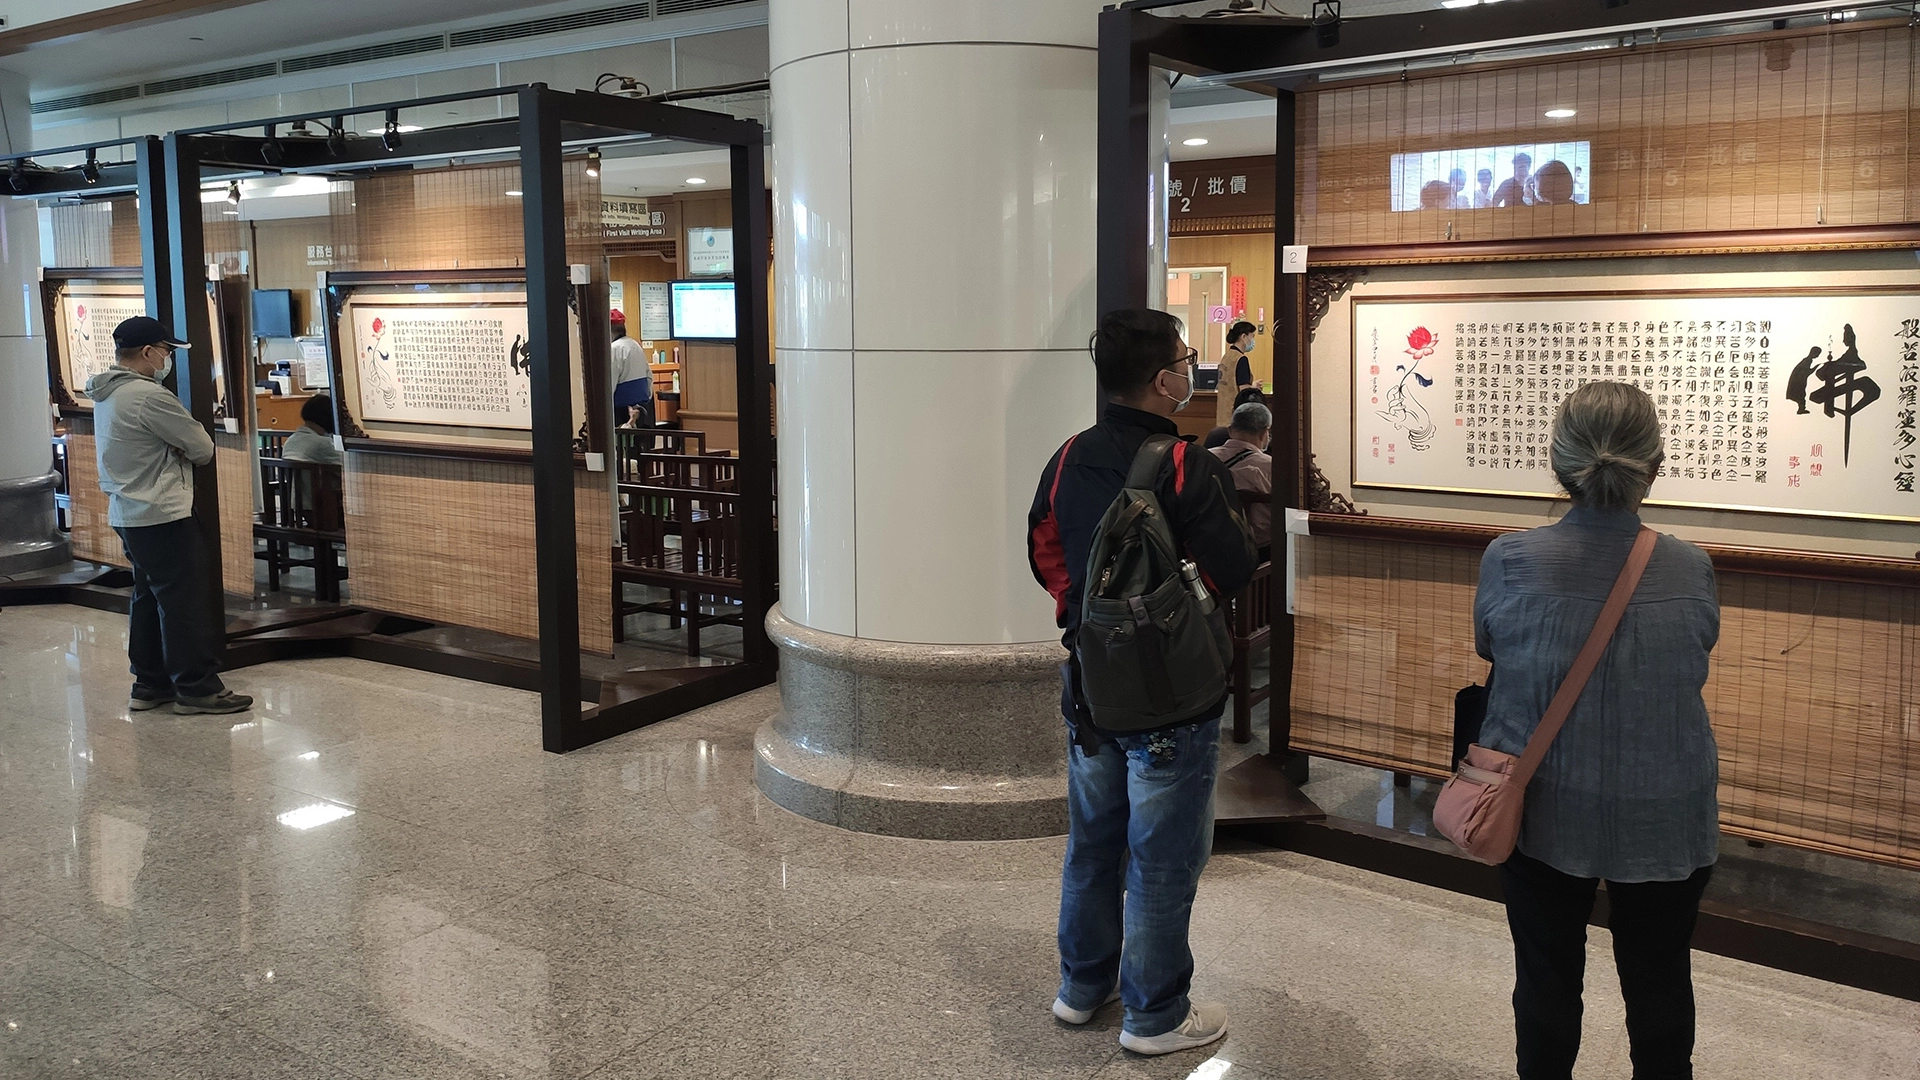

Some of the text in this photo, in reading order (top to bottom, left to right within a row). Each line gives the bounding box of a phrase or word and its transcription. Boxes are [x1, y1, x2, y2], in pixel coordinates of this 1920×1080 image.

[1207, 174, 1248, 196] 批價
[1180, 197, 1191, 213] 2
[1289, 251, 1298, 264] 2
